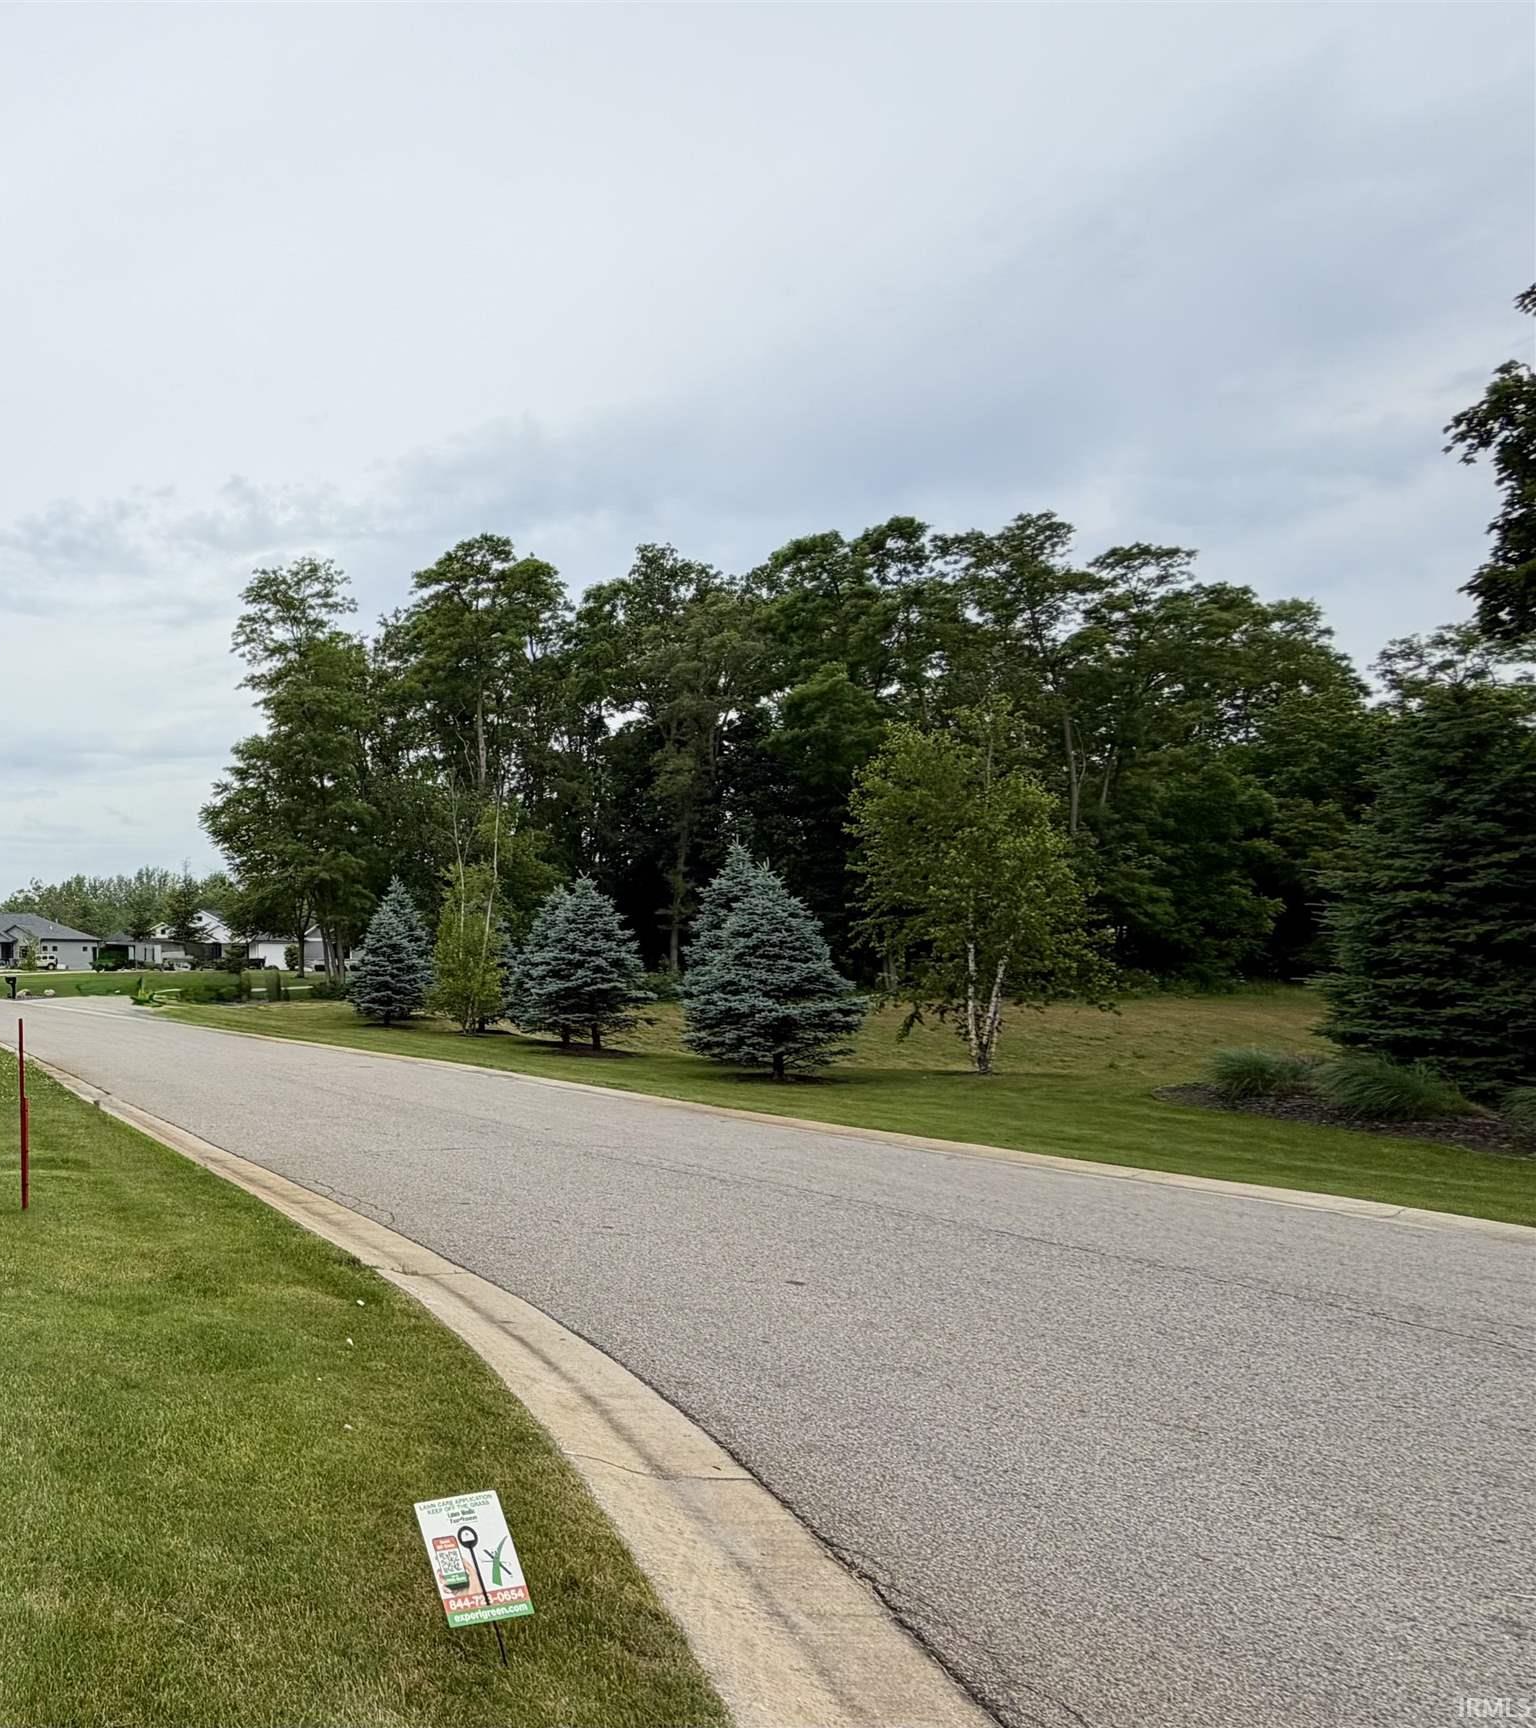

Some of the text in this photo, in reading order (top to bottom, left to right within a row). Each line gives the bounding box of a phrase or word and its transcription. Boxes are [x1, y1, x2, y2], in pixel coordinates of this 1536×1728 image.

[455, 1494, 492, 1504] APPLICATION
[470, 1500, 490, 1508] GRASS
[454, 1603, 528, 1622] experigreen.com
